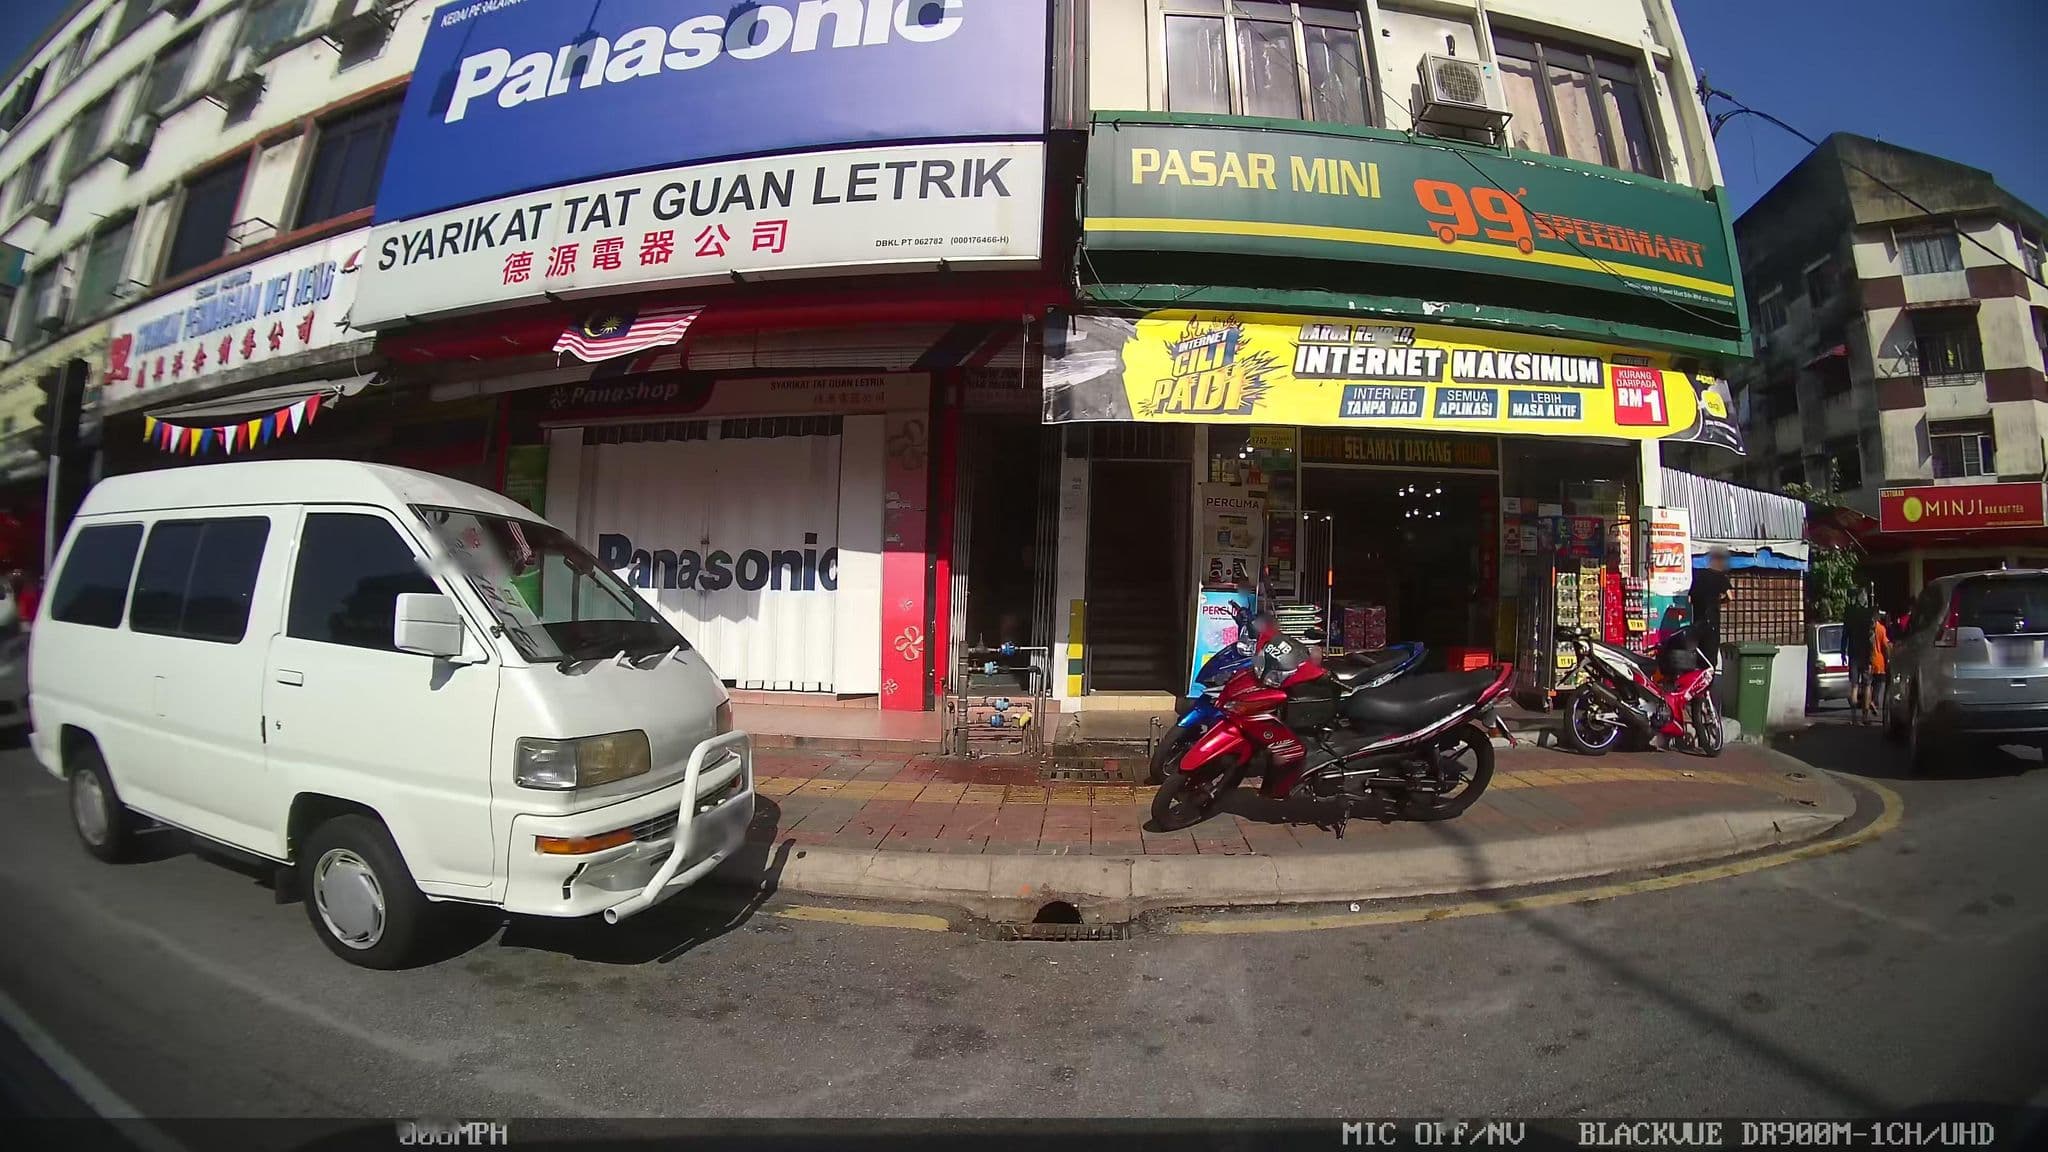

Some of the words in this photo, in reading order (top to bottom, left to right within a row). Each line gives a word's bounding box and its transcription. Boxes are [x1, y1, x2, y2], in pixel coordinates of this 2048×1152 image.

[443, 0, 965, 124] Panasonic
[1131, 147, 1276, 190] PASAR
[1291, 154, 1382, 199] MINI
[377, 202, 552, 271] SYARIKAT
[564, 187, 641, 233] TAT
[652, 168, 796, 222] GUAN
[812, 157, 1013, 203] LETRIK
[1412, 178, 1535, 254] 99
[1532, 210, 1706, 269] SPEEDMART
[502, 219, 789, 286] 德源電器公司
[875, 239, 899, 247] DBKL
[901, 238, 913, 246] PT
[1178, 328, 1230, 353] INTERNET
[1172, 341, 1227, 377] CILI
[1293, 346, 1443, 378] INTERNET
[1451, 349, 1600, 386] MAKSIMUM
[1616, 379, 1658, 389] DARIPADA
[1618, 370, 1652, 380] KURANG
[571, 382, 679, 404] Panashop
[1151, 364, 1246, 413] PADI
[1352, 387, 1416, 401] INTERNET
[1446, 390, 1488, 403] SEMUA
[1530, 393, 1561, 404] LEBIH
[1347, 400, 1386, 415] TANPA
[1390, 401, 1417, 416] HAD
[1438, 402, 1493, 416] APLIKASI
[1512, 403, 1544, 417] MASA
[1546, 404, 1576, 418] AKTIF
[1344, 436, 1401, 462] SELAMAT
[1206, 497, 1260, 510] PERCUMA
[1925, 499, 1983, 517] MINJI
[599, 532, 839, 592] Panasonic
